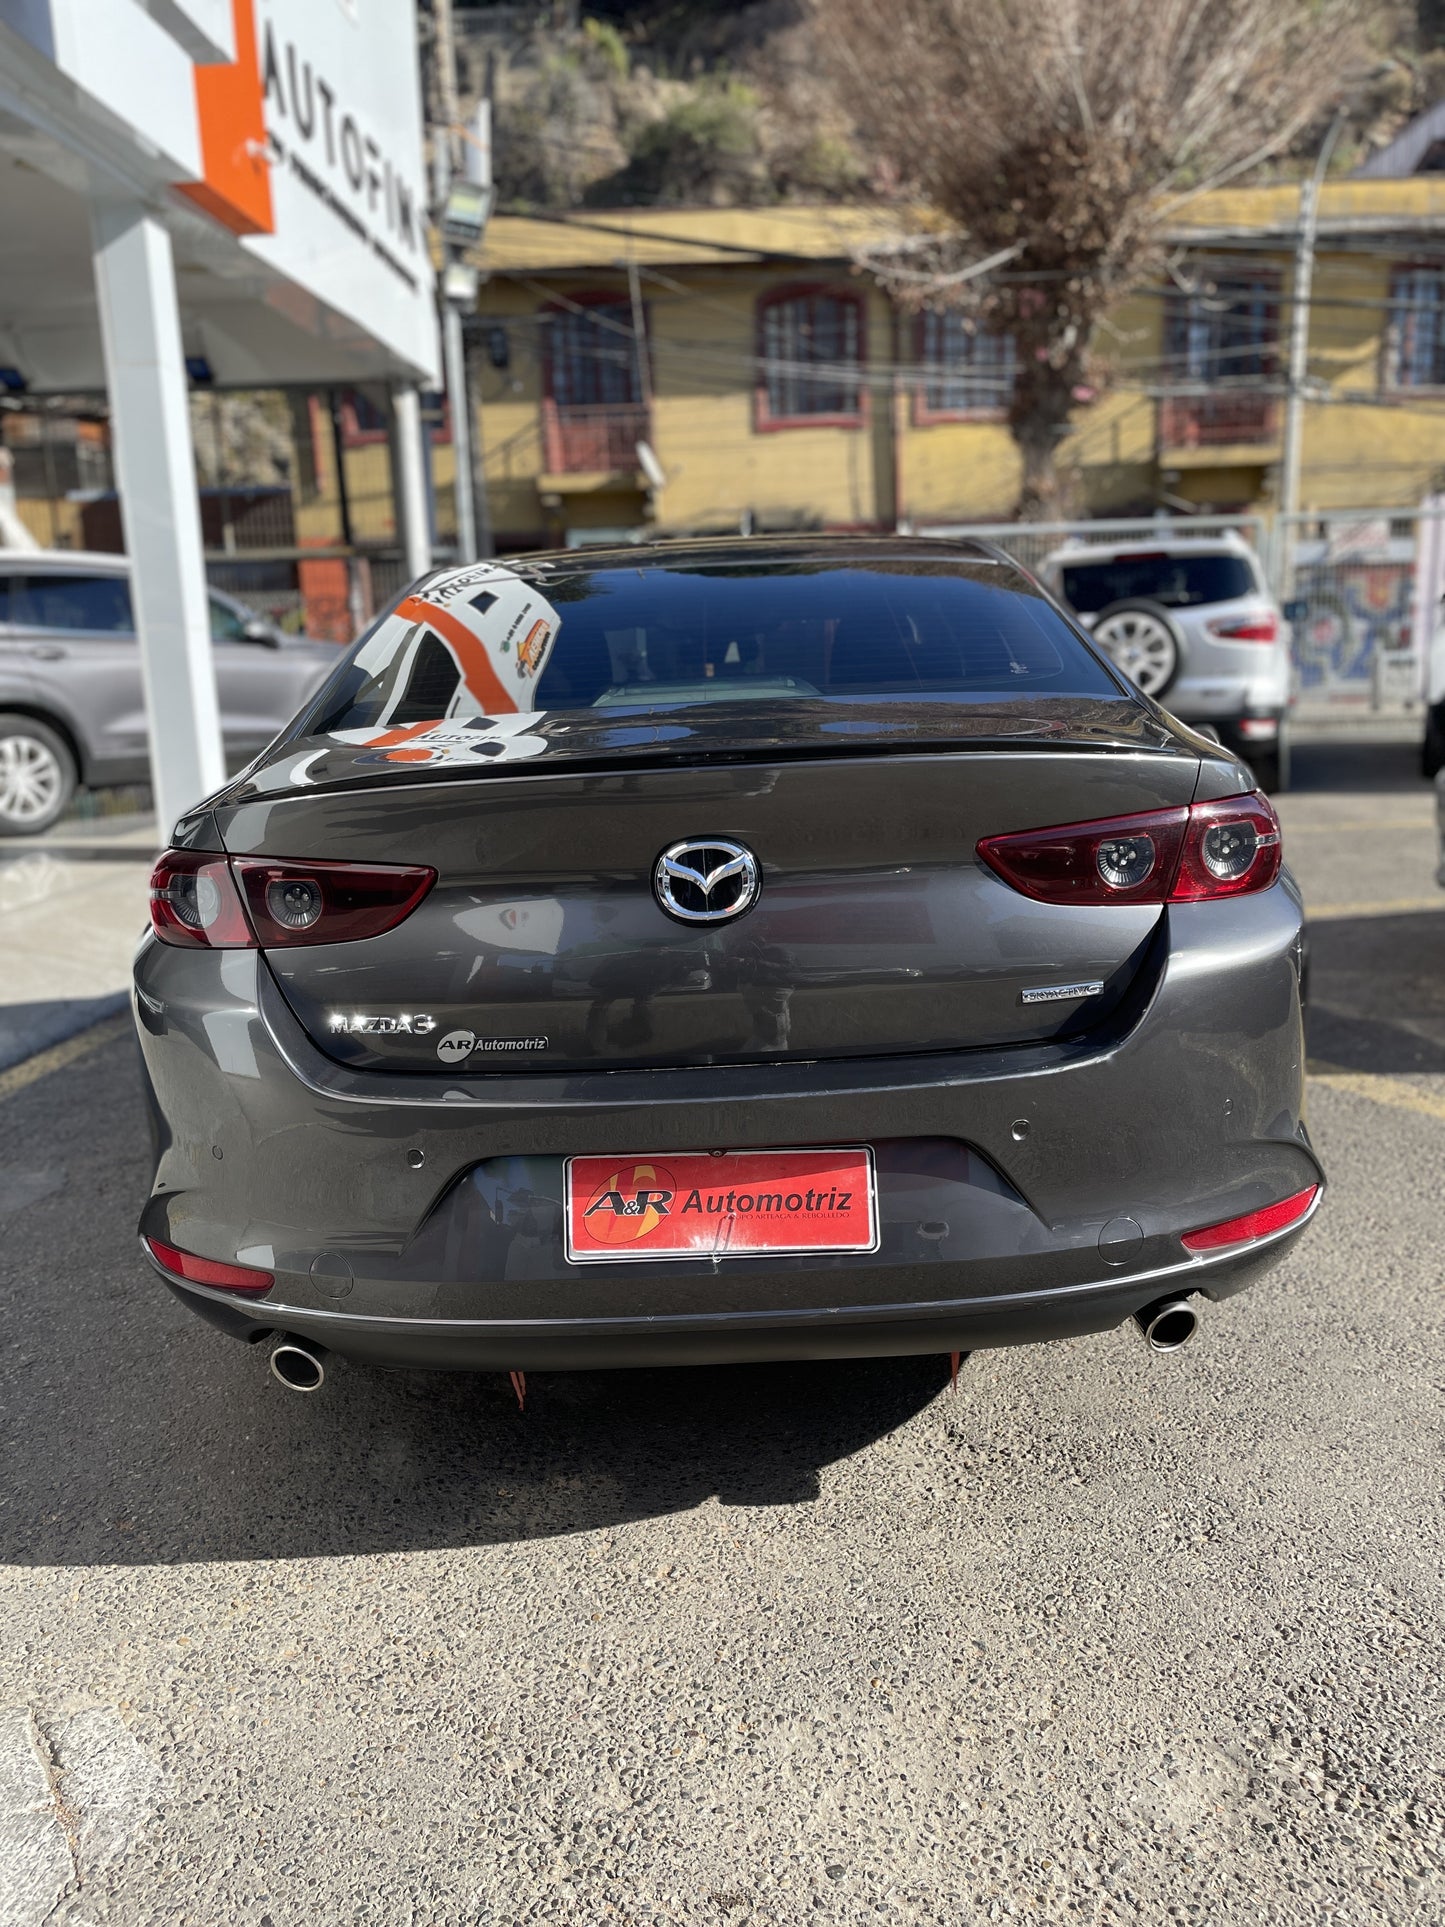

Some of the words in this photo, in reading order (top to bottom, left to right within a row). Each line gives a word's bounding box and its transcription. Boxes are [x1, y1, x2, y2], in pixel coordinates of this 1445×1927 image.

[474, 1038, 546, 1051] Automotriz
[582, 1190, 673, 1217] A&R
[681, 1187, 853, 1214] Automotriz
[755, 1212, 790, 1220] ARTEAGA
[801, 1211, 850, 1219] REBOLLEDO
